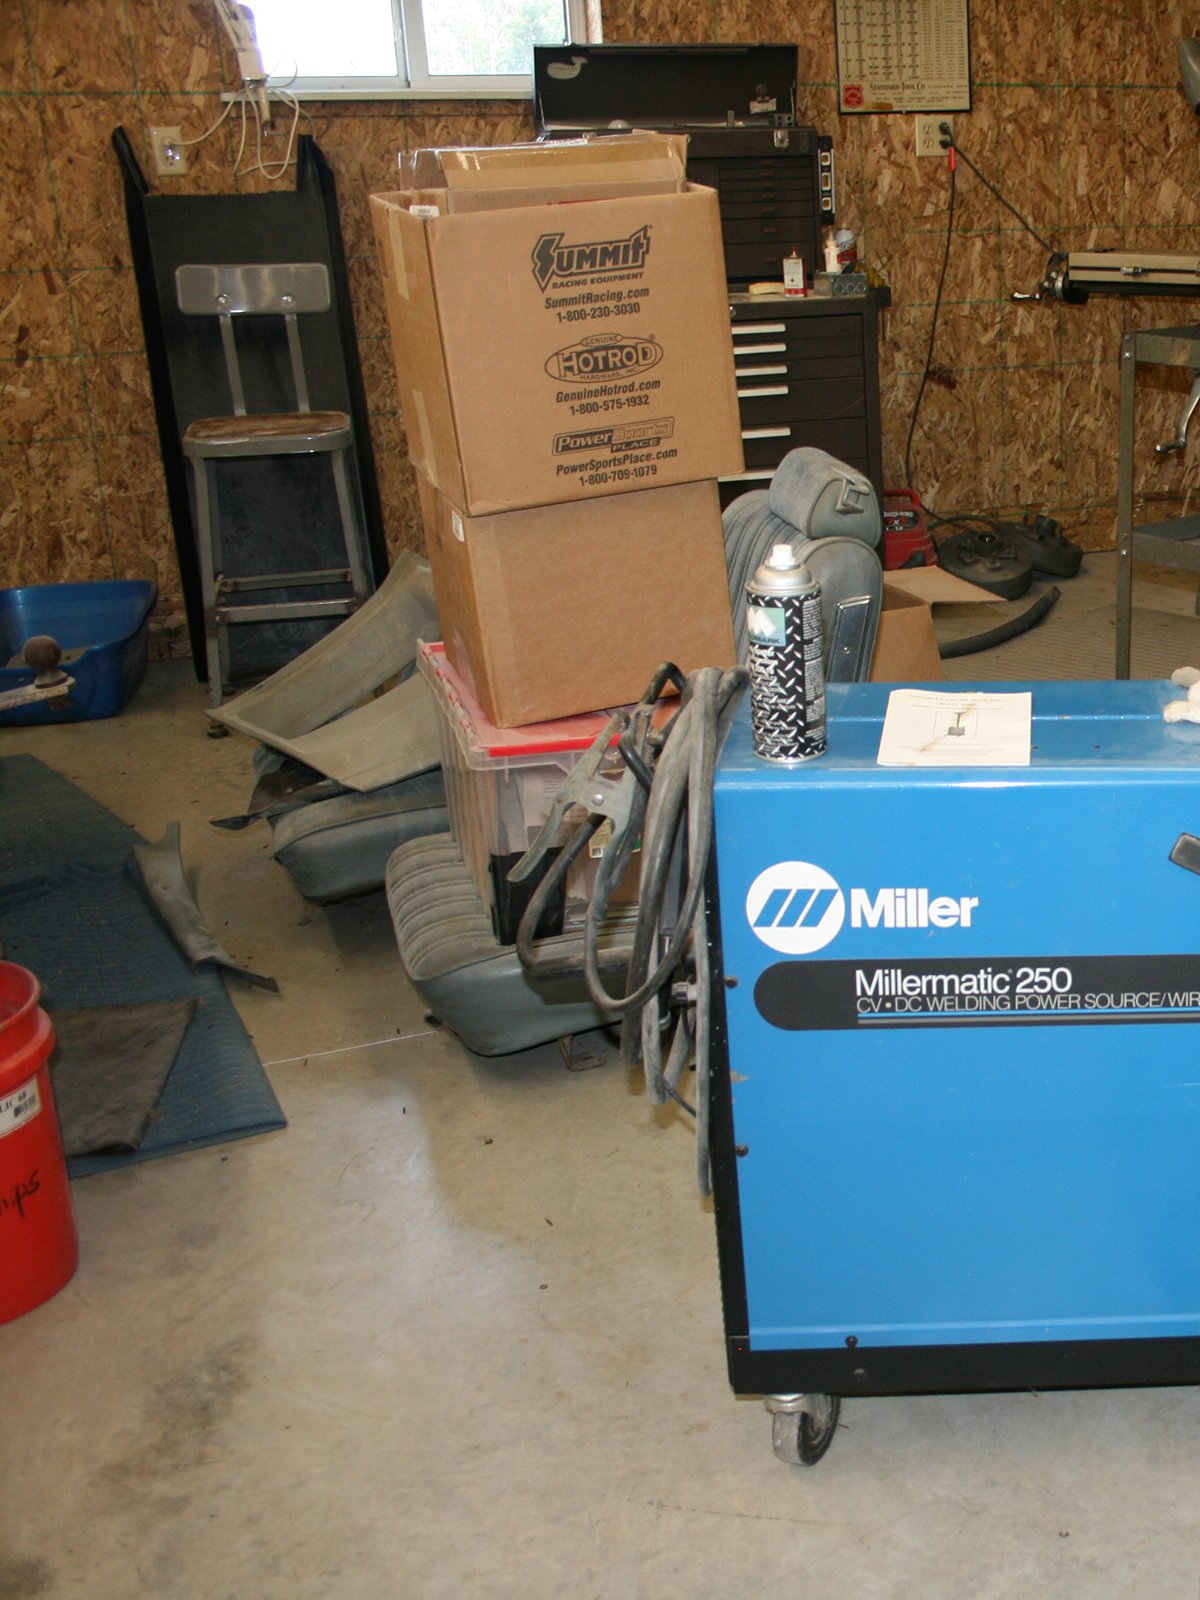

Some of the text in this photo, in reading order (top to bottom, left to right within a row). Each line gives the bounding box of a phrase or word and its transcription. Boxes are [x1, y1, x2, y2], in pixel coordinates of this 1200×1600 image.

[552, 271, 644, 289] RACING EQUIPMENT
[544, 287, 650, 309] SummitRacing.com
[555, 302, 641, 323] 1-800-230-3030
[584, 334, 619, 346] GENUINE
[556, 341, 658, 378] HOTROD
[555, 380, 661, 404] GenuineHotrod.com
[569, 394, 651, 416] 1-800-575-1932
[557, 432, 613, 452] Power
[611, 438, 659, 452] PLACE
[556, 447, 678, 476] PowerSportsPlace.com
[578, 464, 658, 487] 1-800-709-1079
[850, 887, 979, 929] Miller
[855, 966, 1073, 996] Millermatic 250
[856, 996, 882, 1014] CV
[894, 995, 922, 1012] DC
[926, 994, 1011, 1012] WELDING
[1014, 993, 1081, 1011] POWER
